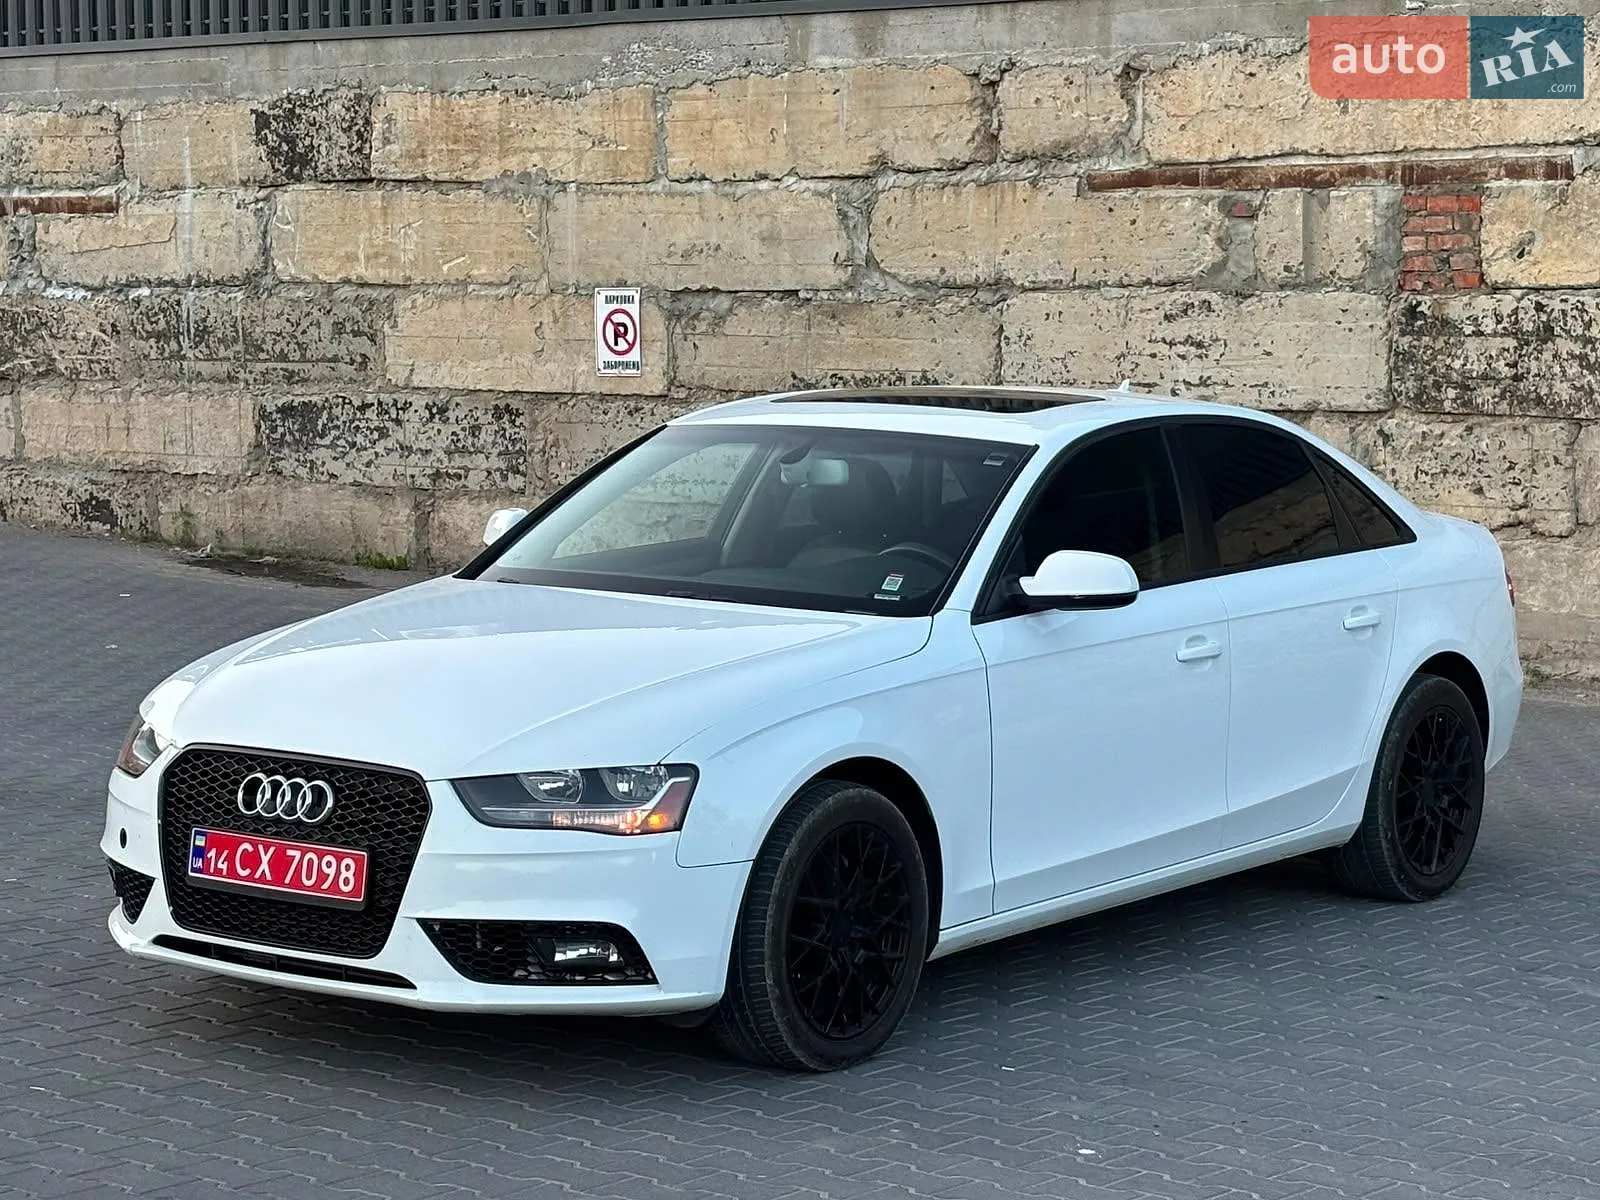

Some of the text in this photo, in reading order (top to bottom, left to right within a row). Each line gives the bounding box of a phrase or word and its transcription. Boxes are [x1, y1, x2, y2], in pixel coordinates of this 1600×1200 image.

[192, 857, 203, 869] UA
[207, 842, 356, 893] 14 CX 7098
